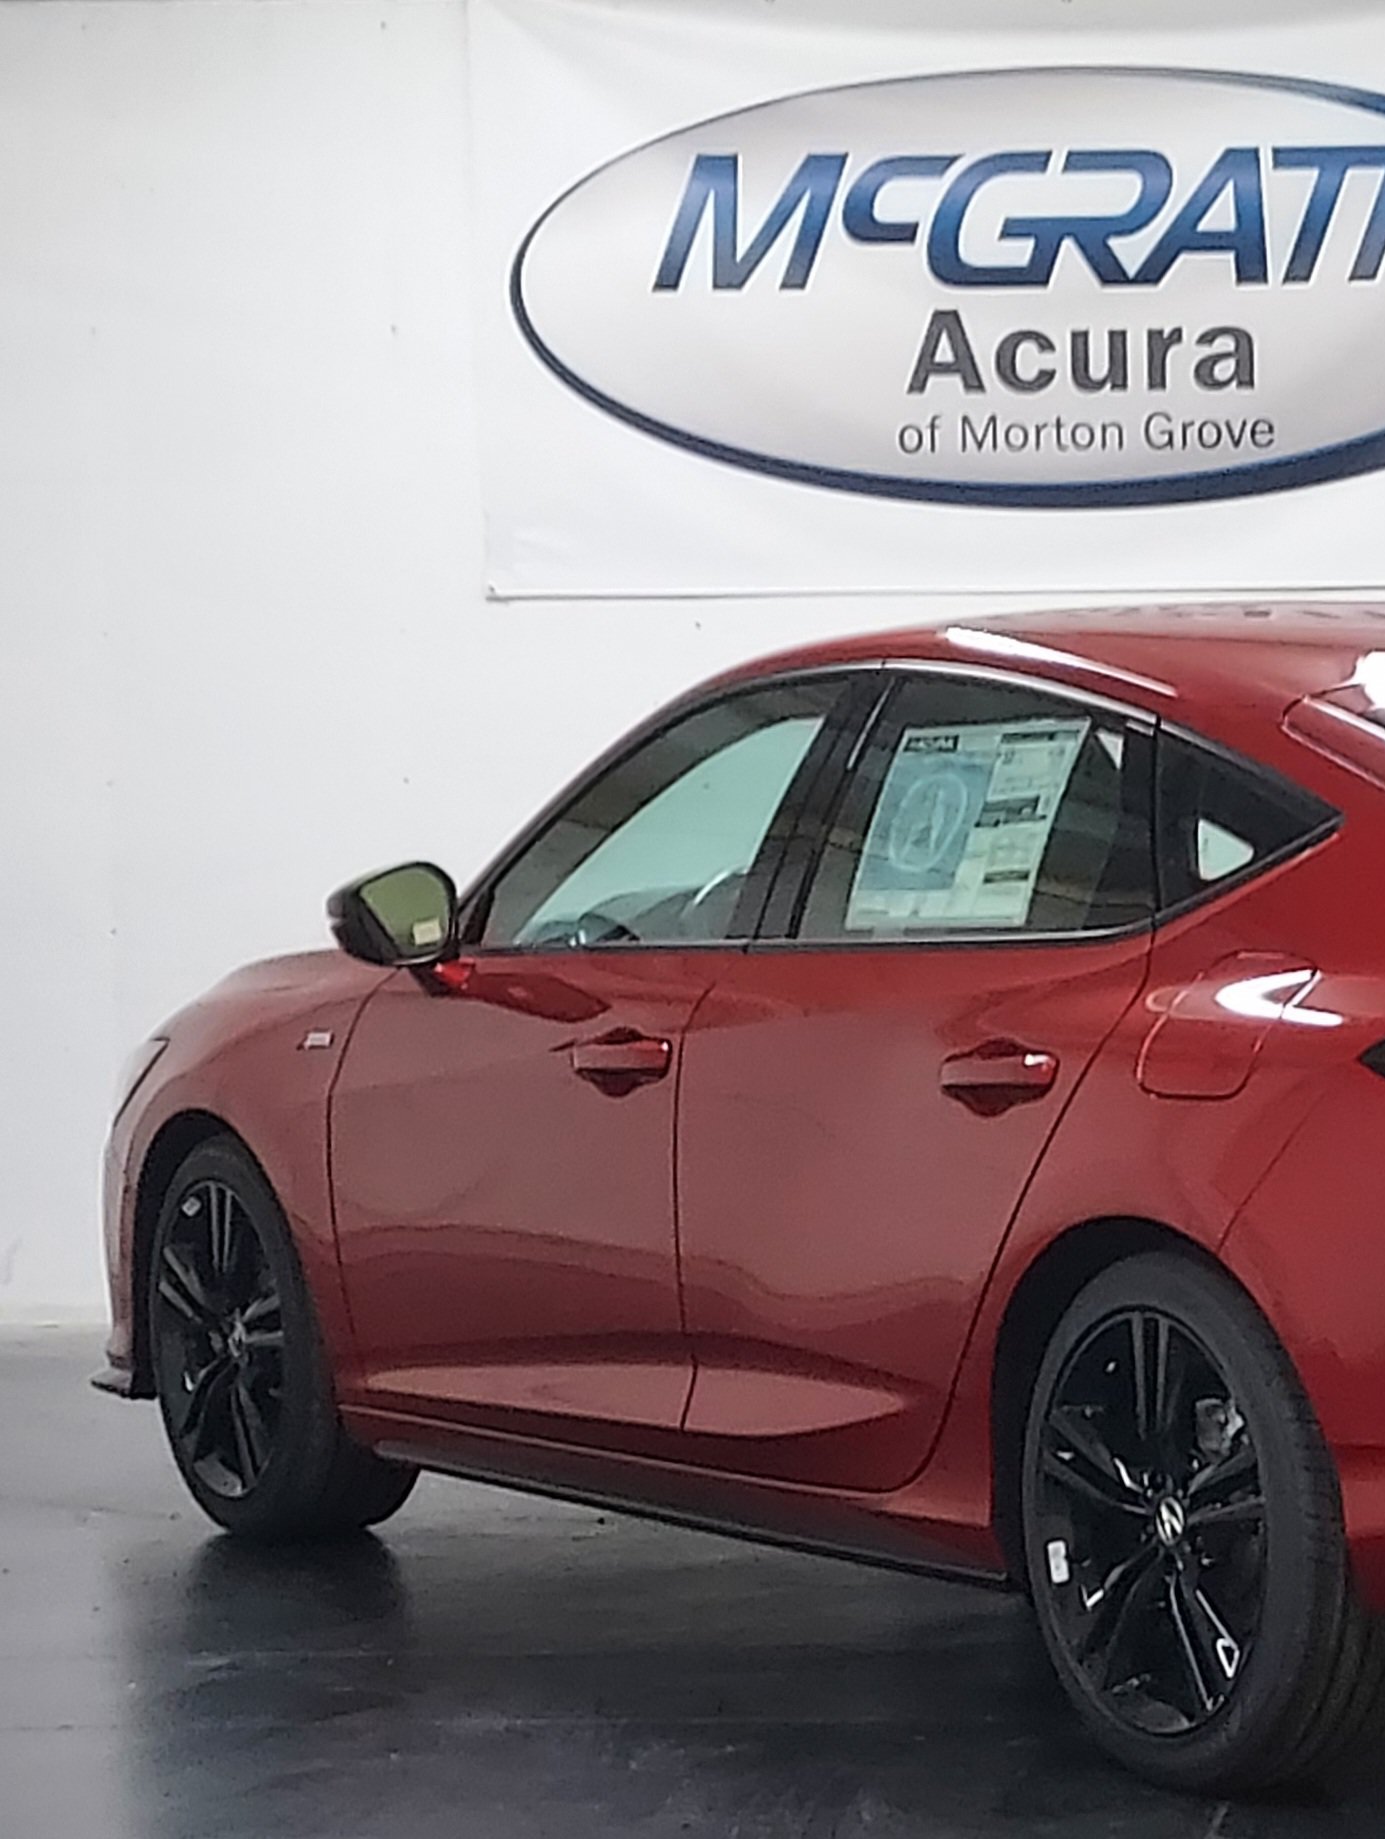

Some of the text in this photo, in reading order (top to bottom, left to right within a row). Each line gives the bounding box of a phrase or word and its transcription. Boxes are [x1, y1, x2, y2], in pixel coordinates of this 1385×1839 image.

[907, 309, 1255, 393] Acura
[898, 411, 1276, 453] of Morton Grove
